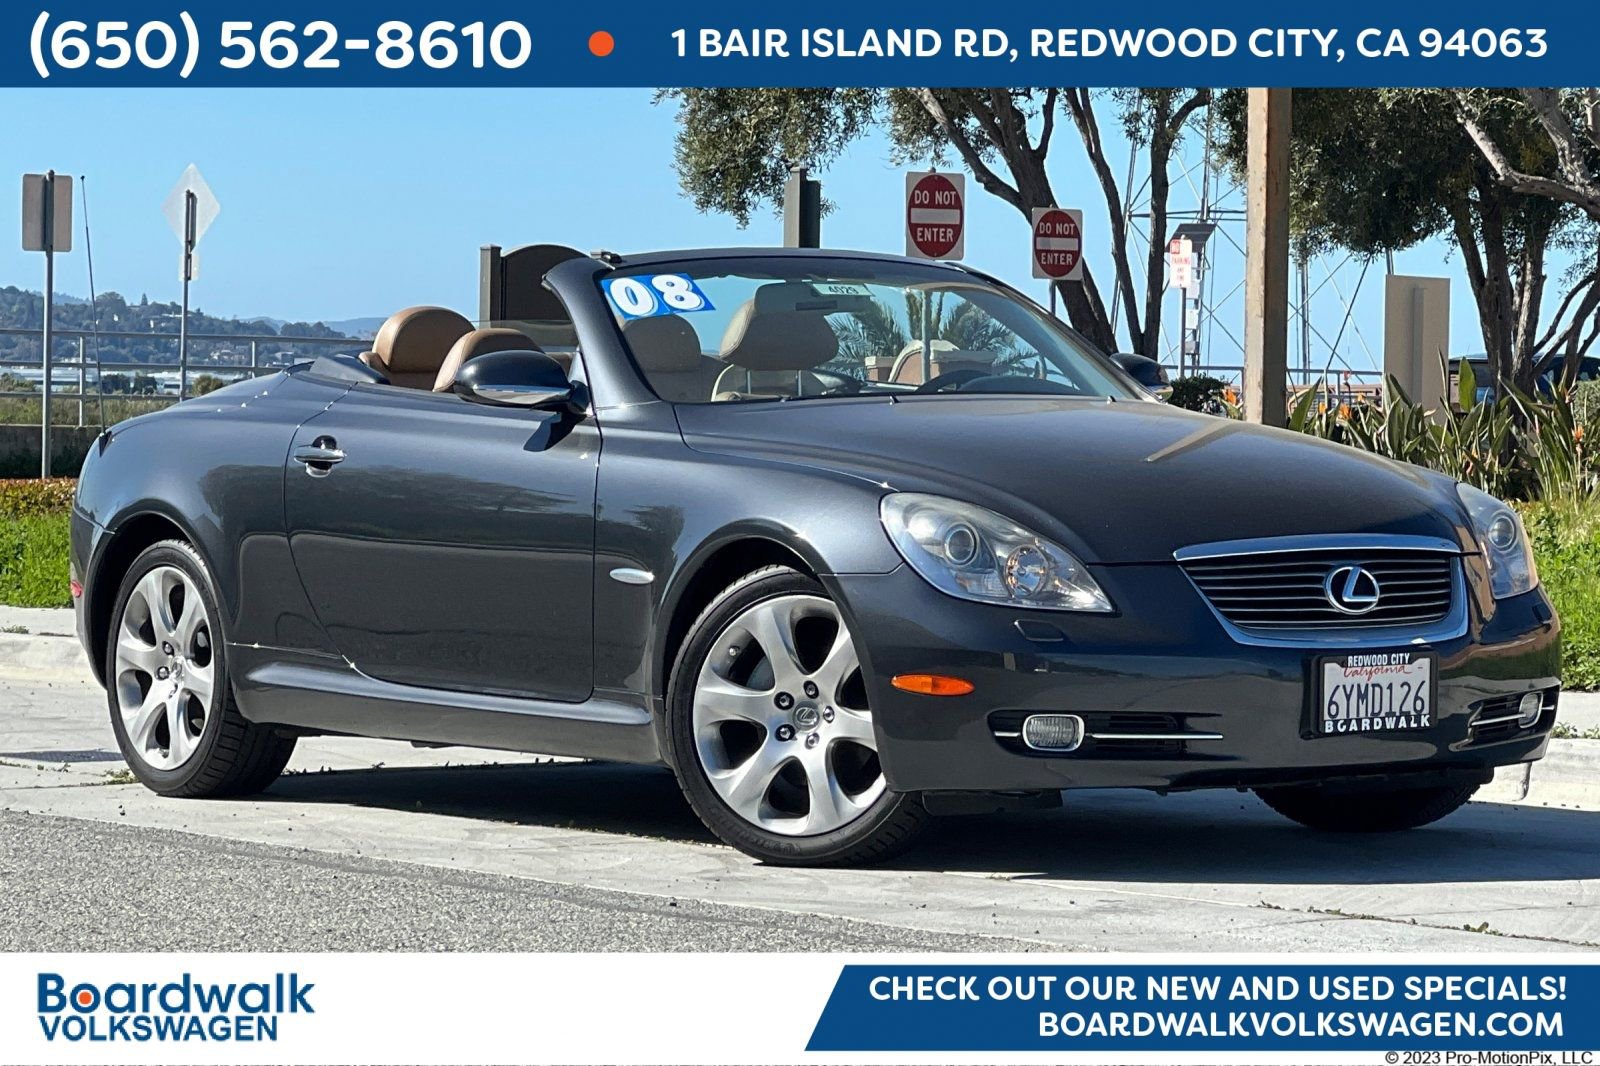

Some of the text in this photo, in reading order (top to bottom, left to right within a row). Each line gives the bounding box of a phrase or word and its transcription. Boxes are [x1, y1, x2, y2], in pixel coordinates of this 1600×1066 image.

[914, 190, 957, 206] DO NOT
[917, 227, 954, 242] ENTER
[1039, 222, 1075, 235] DO NOT
[1041, 252, 1073, 265] ENTER
[609, 274, 705, 317] 08
[1347, 653, 1410, 667] REDWOOD CITY
[1343, 665, 1412, 681] California
[1327, 680, 1426, 720] 6YMD126
[1325, 715, 1430, 734] BOARDWALK
